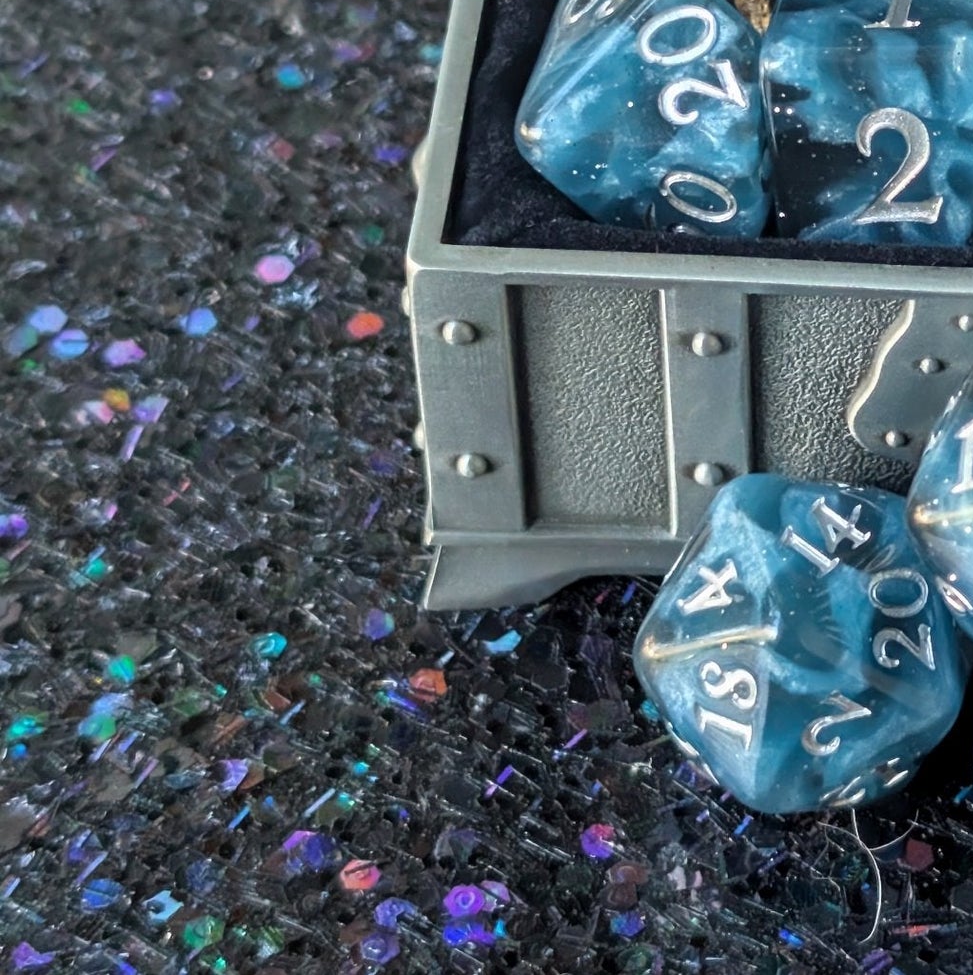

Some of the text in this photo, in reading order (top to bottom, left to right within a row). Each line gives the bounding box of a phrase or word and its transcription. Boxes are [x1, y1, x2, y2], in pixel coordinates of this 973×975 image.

[855, 107, 943, 224] 2
[780, 496, 871, 577] 14
[676, 559, 738, 616] 4
[869, 569, 935, 670] 20
[698, 661, 757, 751] 18
[802, 691, 871, 757] 2
